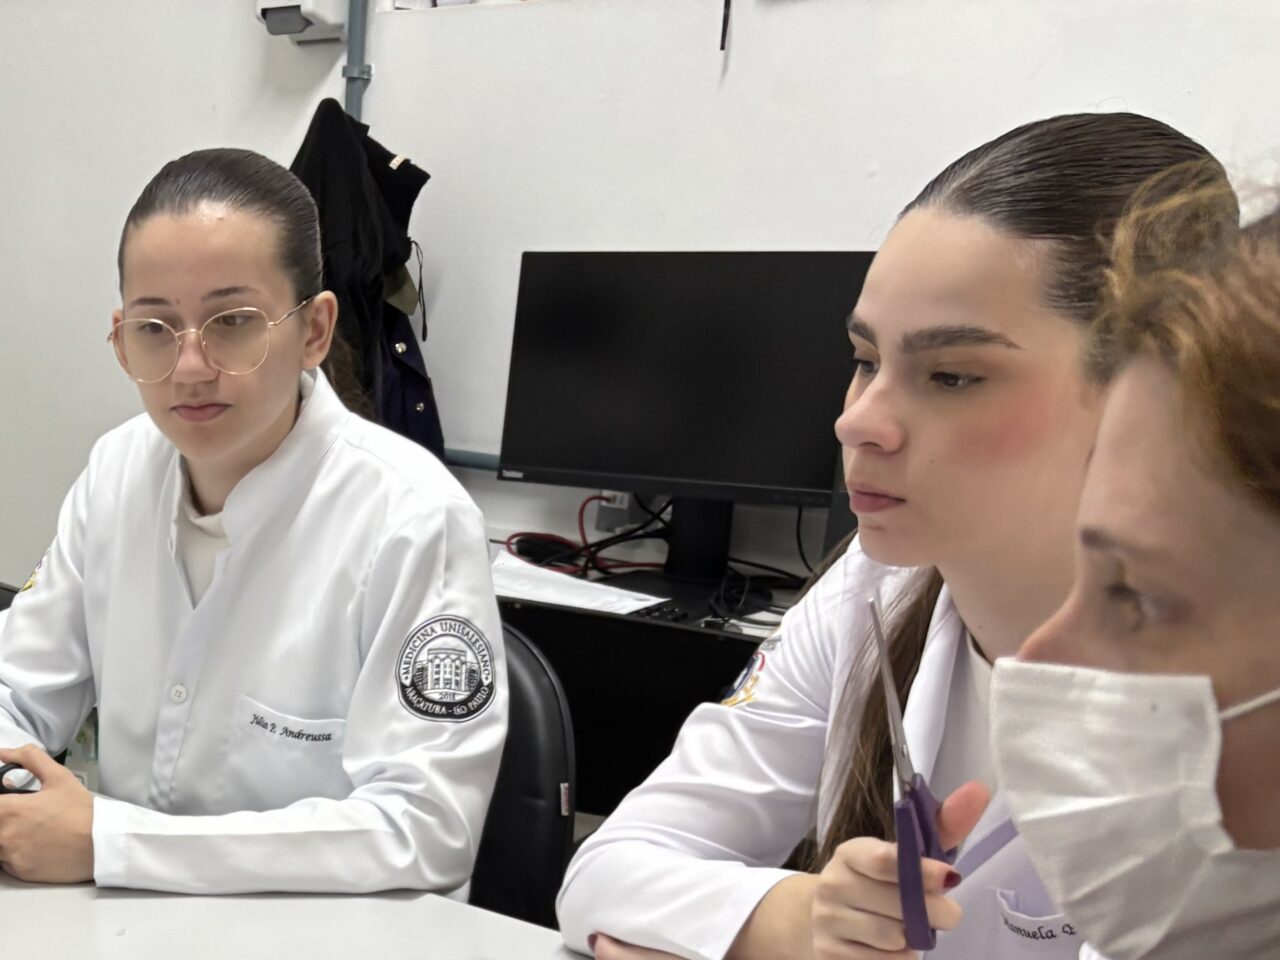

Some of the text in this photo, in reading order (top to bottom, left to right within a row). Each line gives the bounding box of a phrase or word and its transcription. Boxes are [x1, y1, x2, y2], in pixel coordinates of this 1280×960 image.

[402, 622, 492, 677] MEDICINA UNISALESIANO
[405, 686, 448, 714] ARAÇATUBA
